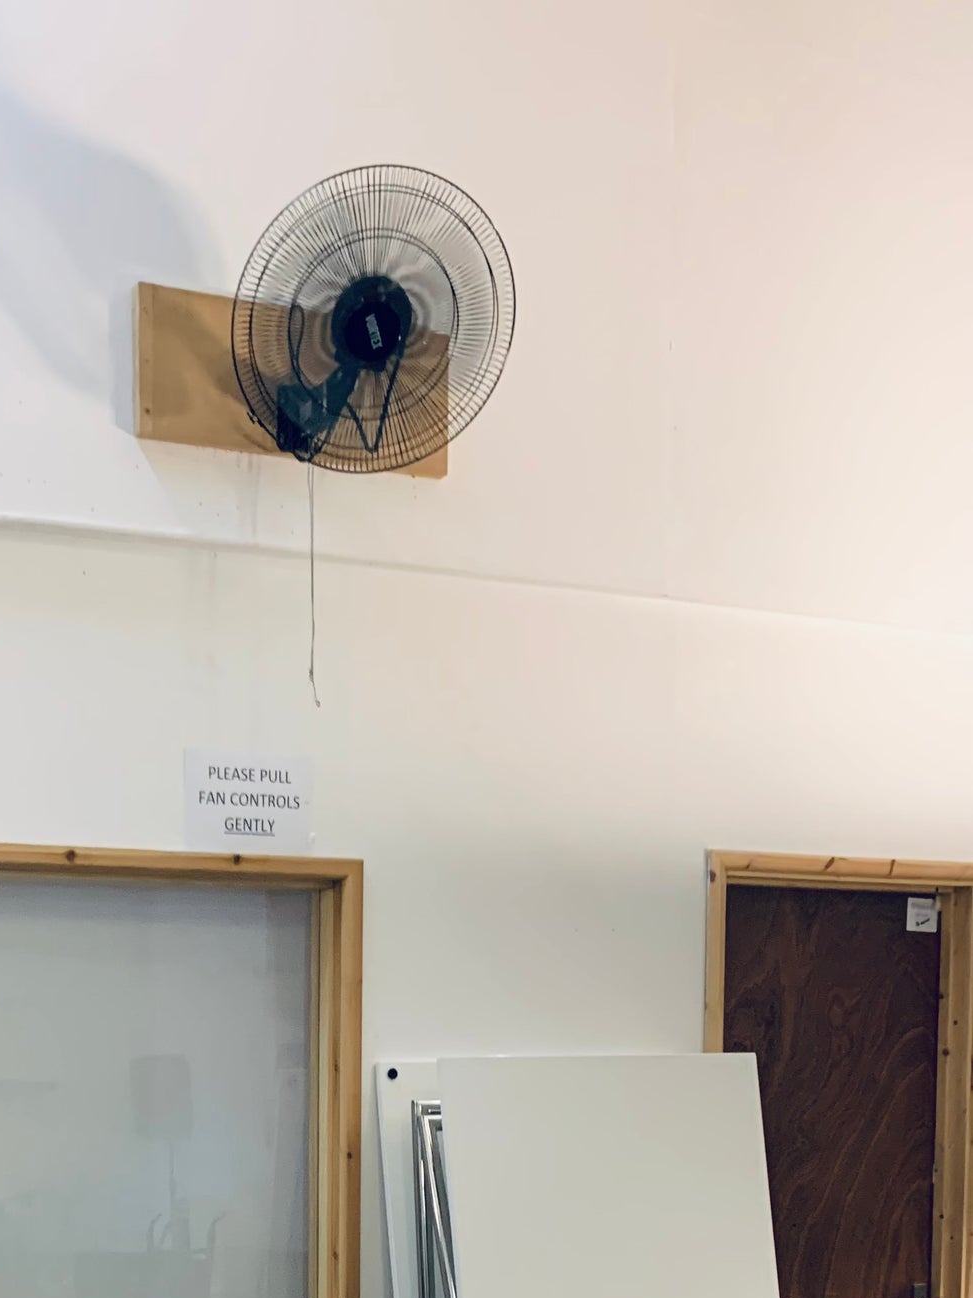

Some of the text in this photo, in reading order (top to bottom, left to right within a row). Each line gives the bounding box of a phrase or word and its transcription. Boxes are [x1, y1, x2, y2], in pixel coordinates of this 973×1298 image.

[208, 766, 292, 784] PLEASE PULL
[199, 791, 300, 810] FAN CONTROLS
[224, 817, 276, 834] GENTLY
